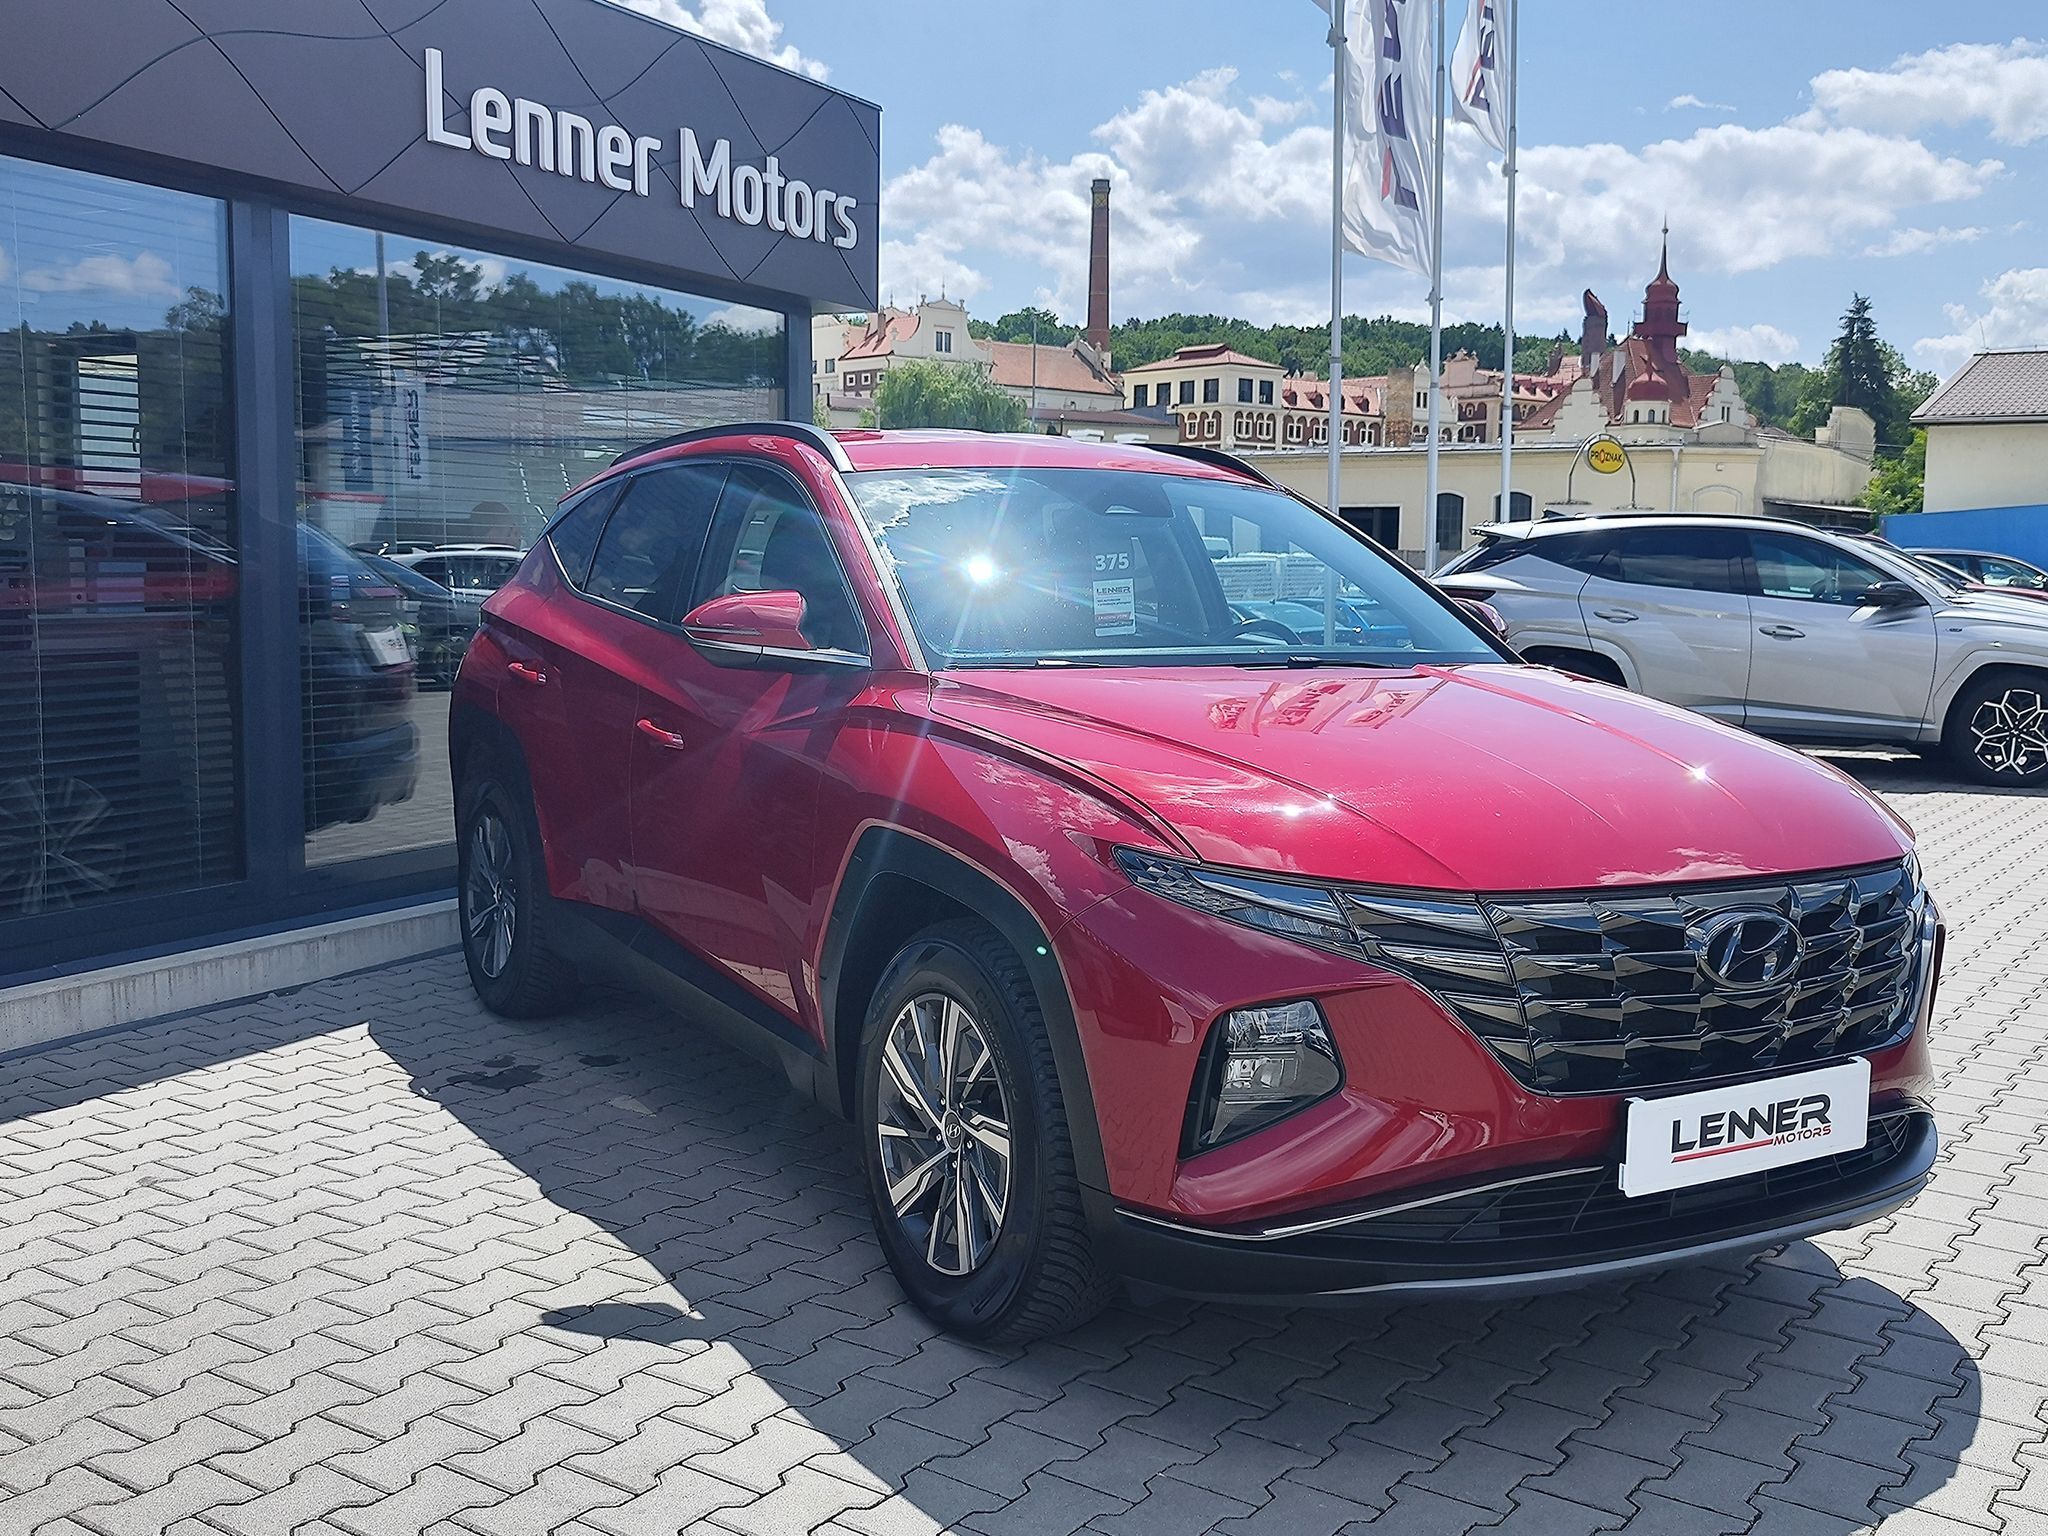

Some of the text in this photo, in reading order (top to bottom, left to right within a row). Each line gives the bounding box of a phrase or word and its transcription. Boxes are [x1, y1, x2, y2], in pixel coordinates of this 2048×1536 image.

[424, 47, 859, 251] Lenner Motors
[1095, 553, 1130, 571] 375
[1096, 586, 1131, 594] LENNER
[1671, 1093, 1832, 1154] LENNER
[1773, 1125, 1832, 1146] MOTORS
